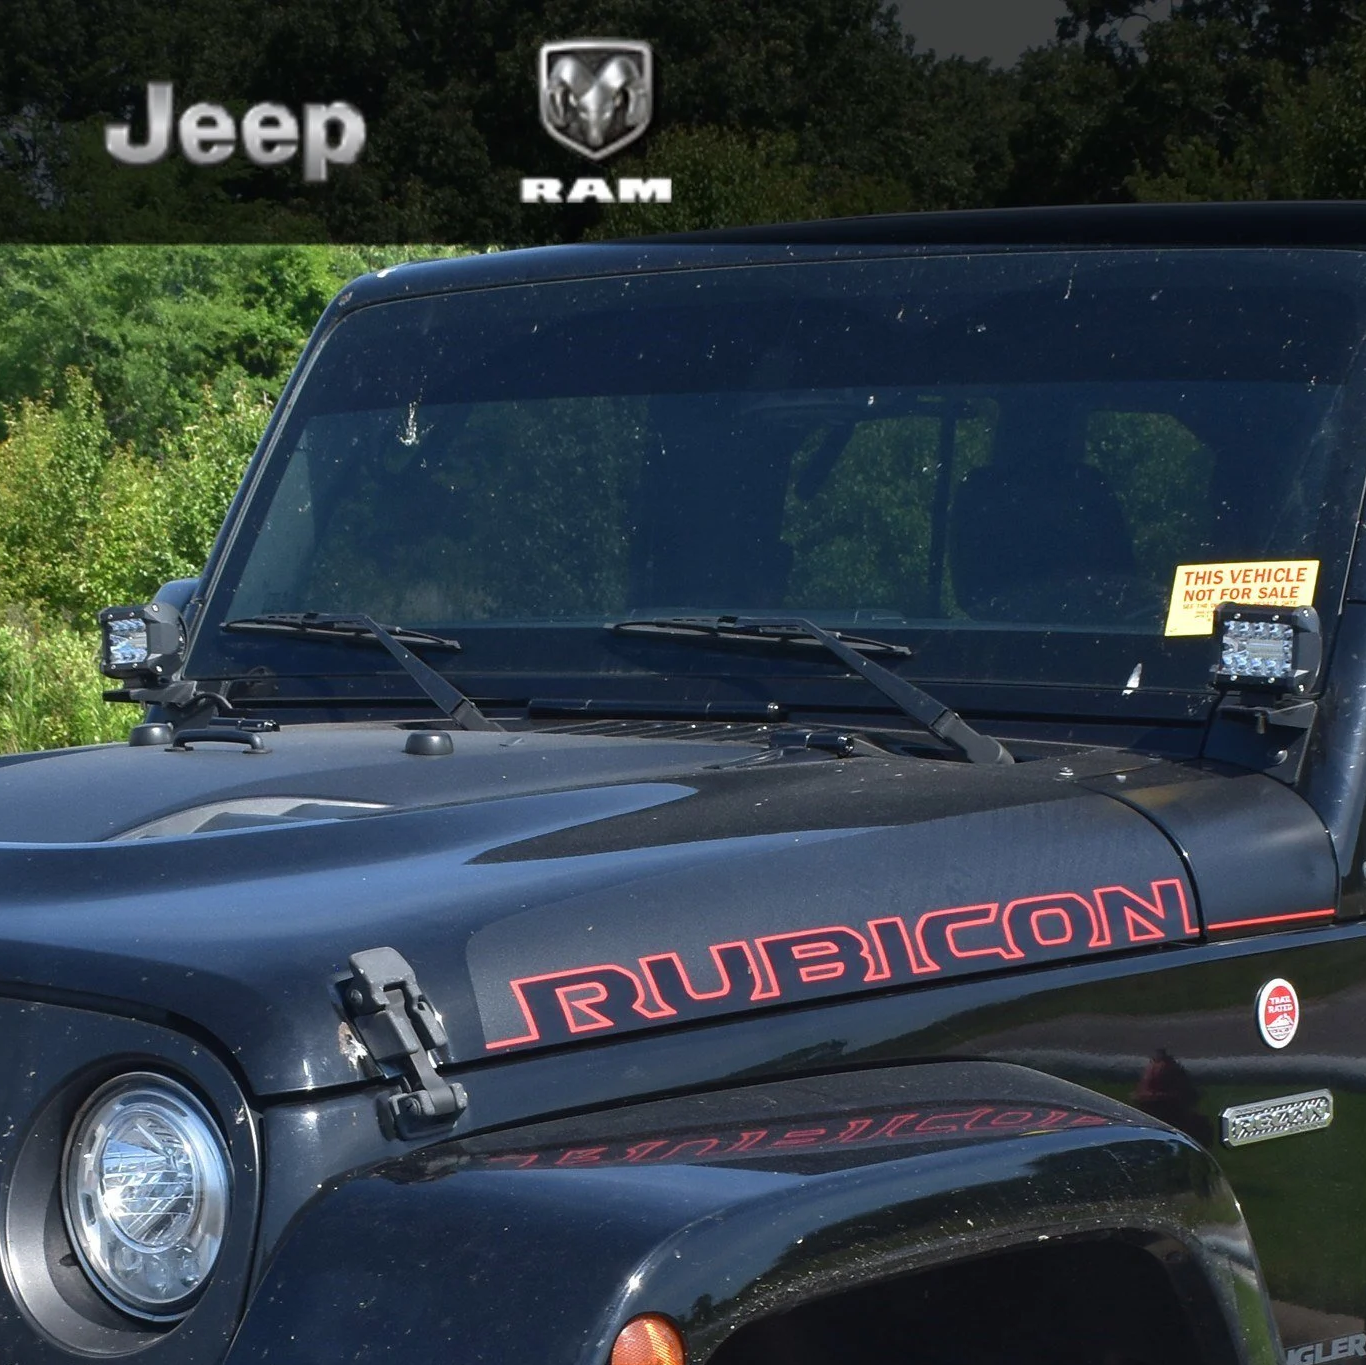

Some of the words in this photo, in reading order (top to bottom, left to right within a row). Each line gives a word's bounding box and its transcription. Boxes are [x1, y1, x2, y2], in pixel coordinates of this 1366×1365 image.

[1184, 570, 1224, 586] THIS
[1230, 567, 1308, 584] VEHICLE
[1183, 588, 1215, 602] NOT
[1219, 587, 1253, 600] FOR
[1257, 586, 1300, 599] SALE
[485, 878, 1201, 1051] RUBICON
[1267, 1004, 1294, 1013] RATED
